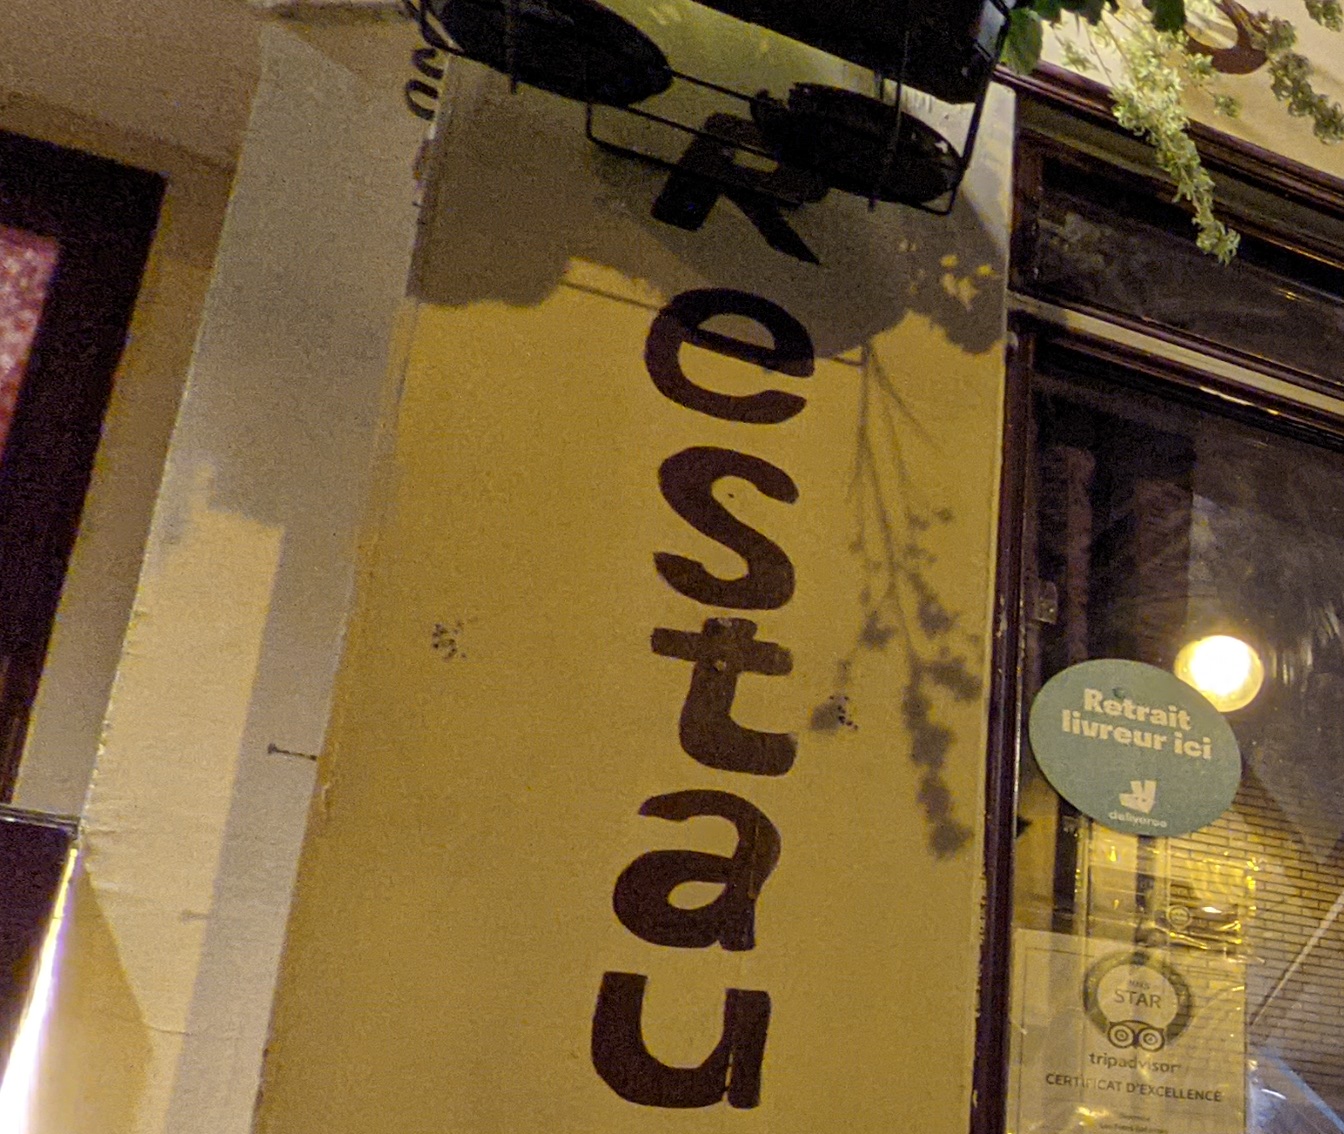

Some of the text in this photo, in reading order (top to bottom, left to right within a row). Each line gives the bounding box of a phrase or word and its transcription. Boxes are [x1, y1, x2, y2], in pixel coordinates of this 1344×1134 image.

[1084, 687, 1192, 731] Retrait
[1061, 709, 1213, 760] livreur ici
[1108, 809, 1169, 829] deliveroo
[1114, 990, 1162, 1009] STAR
[1127, 1082, 1223, 1102] D'EXCELLENCE
